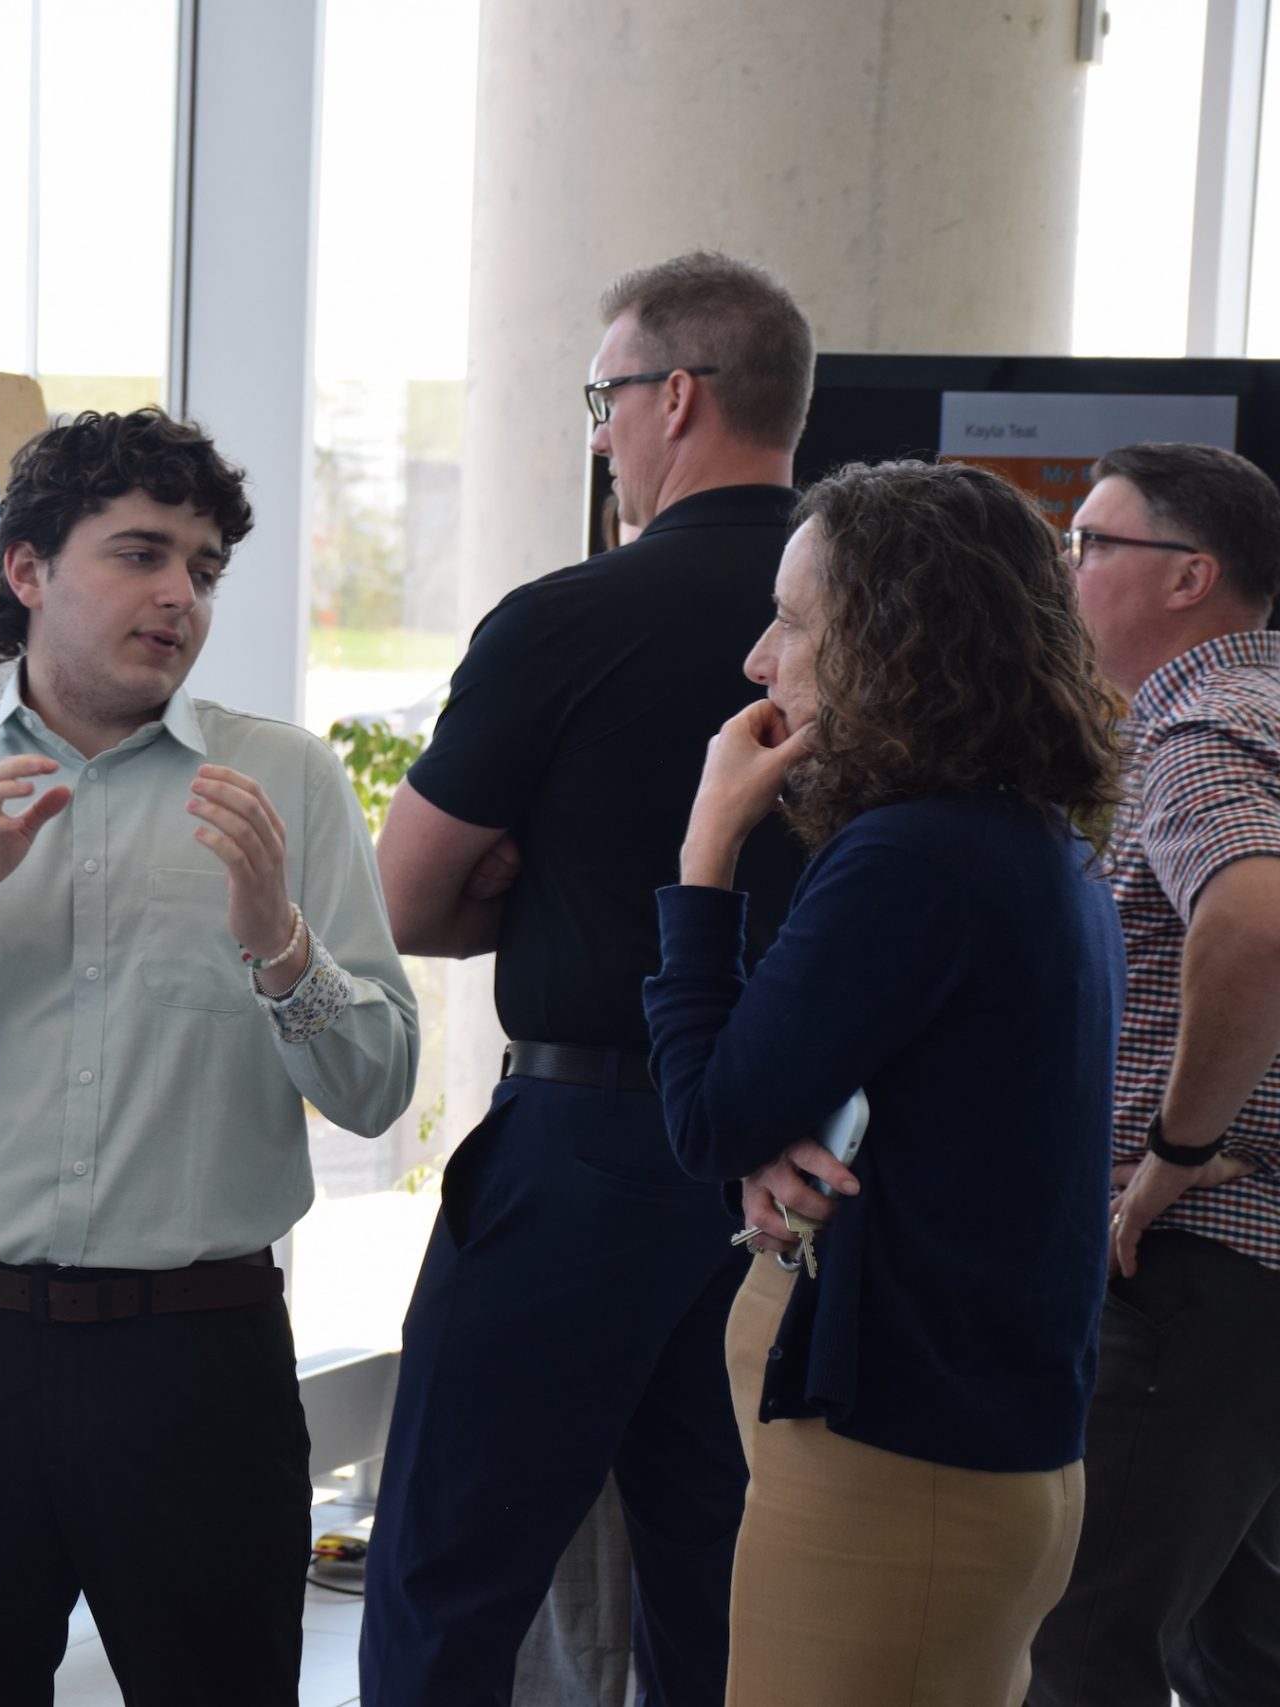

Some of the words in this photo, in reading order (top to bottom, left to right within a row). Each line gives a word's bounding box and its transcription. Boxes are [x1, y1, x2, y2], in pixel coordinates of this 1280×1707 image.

[965, 423, 1004, 440] Kayla
[1008, 423, 1038, 438] Teal
[1042, 464, 1074, 485] My
